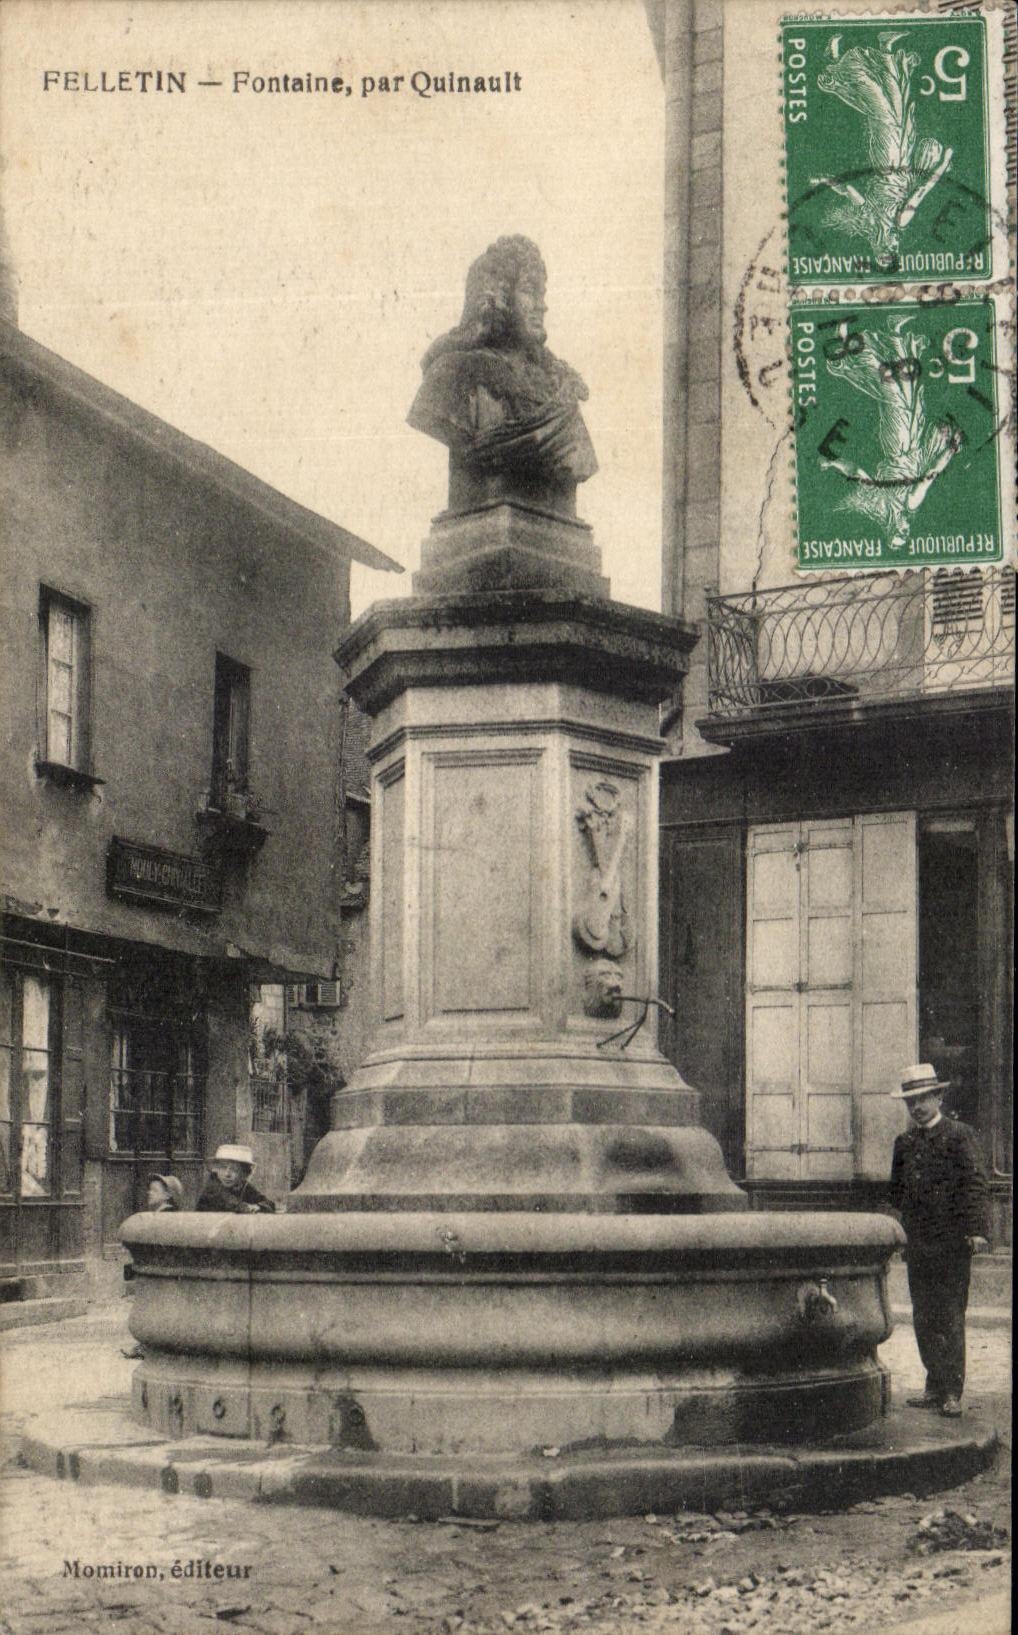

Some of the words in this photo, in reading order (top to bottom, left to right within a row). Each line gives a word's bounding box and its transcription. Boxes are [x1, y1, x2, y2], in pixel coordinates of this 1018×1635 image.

[788, 38, 807, 123] POSTES
[792, 253, 871, 274] FRANÇAISE
[796, 322, 817, 407] POSTES
[803, 537, 882, 559] FRANÇAISE
